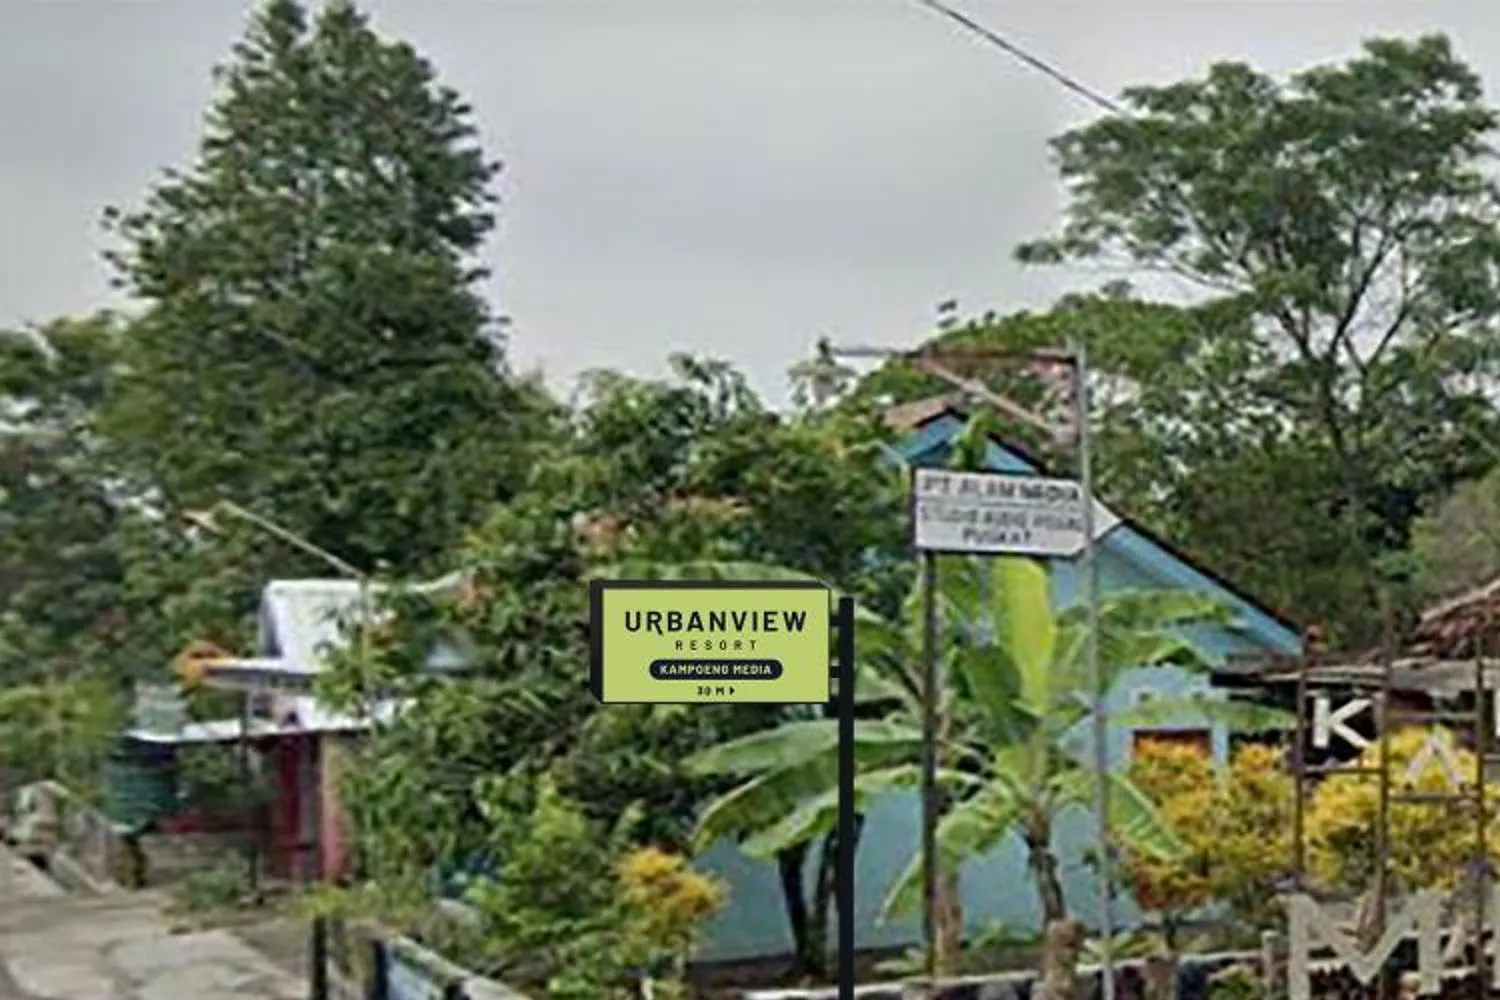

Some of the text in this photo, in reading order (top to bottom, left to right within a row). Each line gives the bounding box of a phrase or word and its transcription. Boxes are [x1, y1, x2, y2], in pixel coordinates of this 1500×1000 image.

[625, 610, 808, 635] URBANVIEW
[675, 639, 758, 651] RESORT
[733, 663, 773, 676] MEDIA
